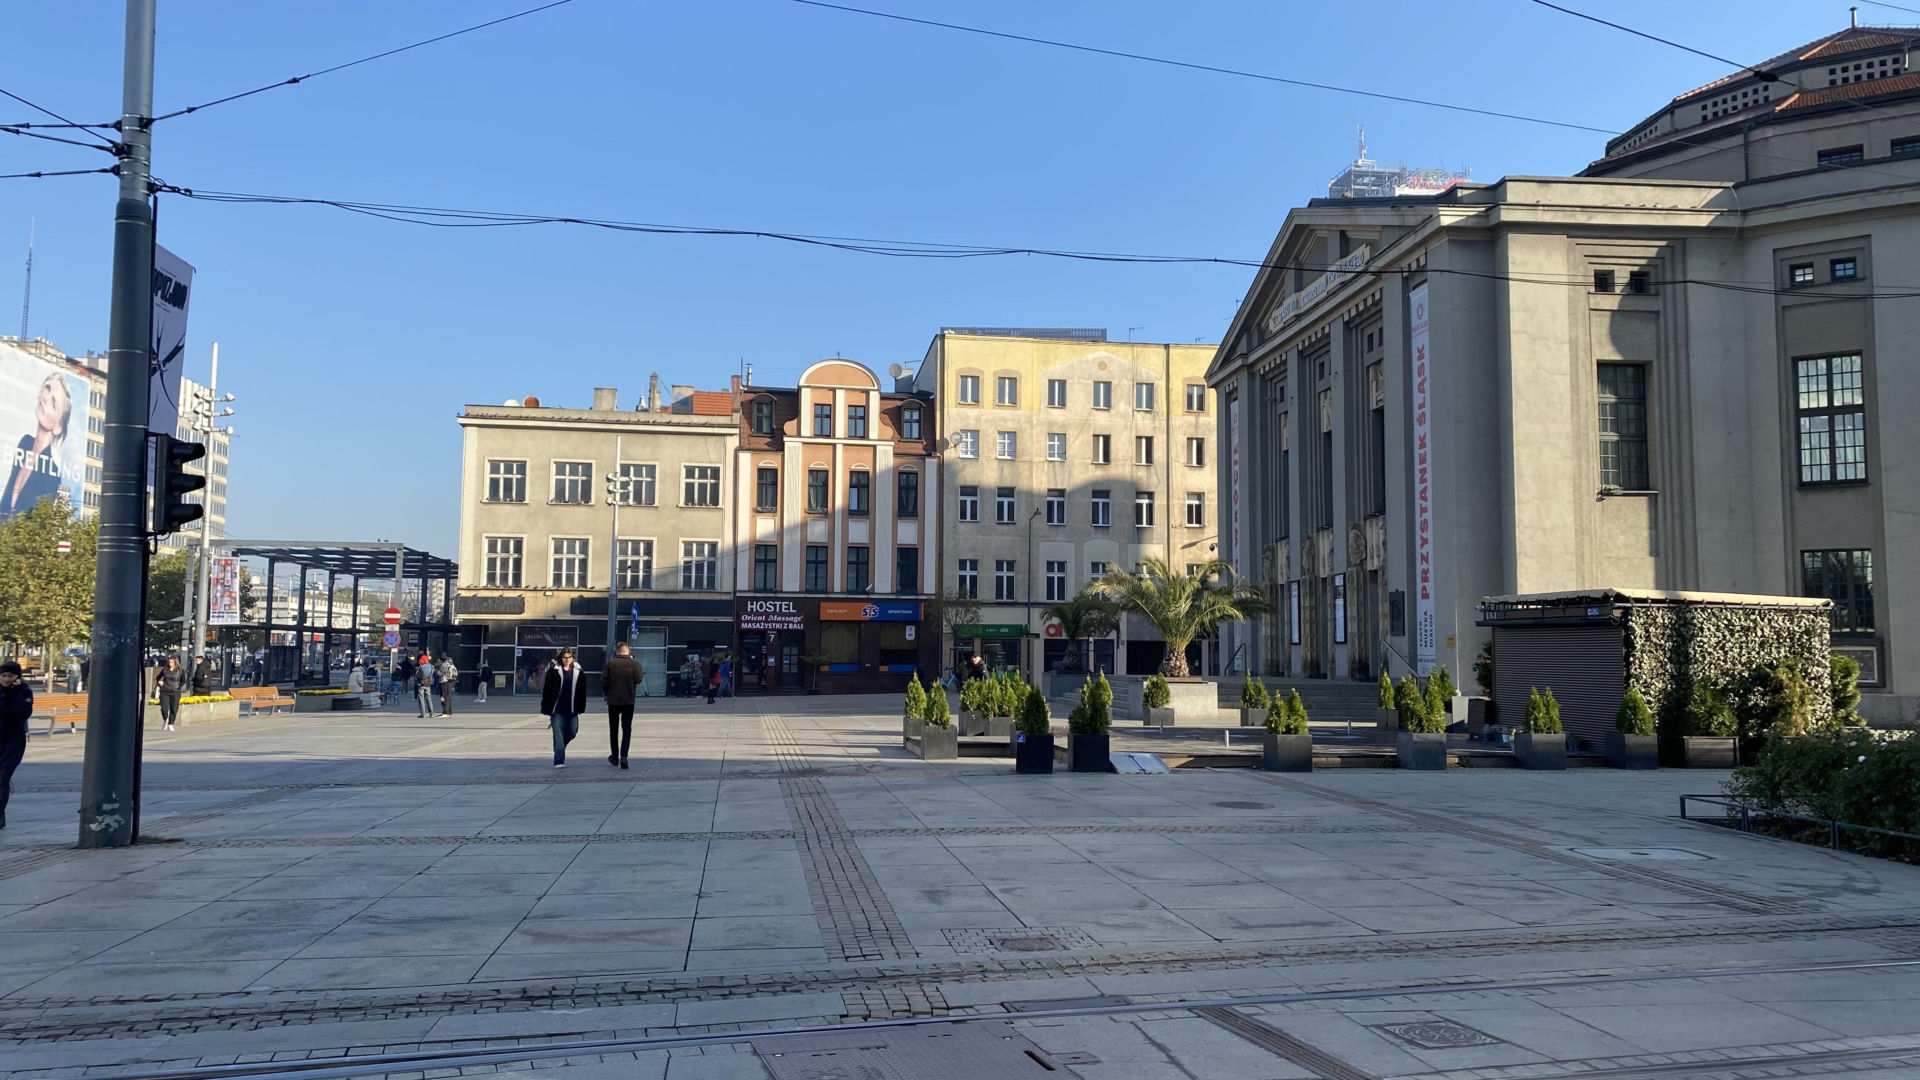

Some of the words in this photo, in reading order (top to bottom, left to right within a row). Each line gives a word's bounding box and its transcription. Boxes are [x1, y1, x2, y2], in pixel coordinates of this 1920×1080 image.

[1416, 344, 1428, 427] ŚLĄSK
[3, 446, 81, 482] BREITLING
[1418, 432, 1430, 600] PRZYSTANEK
[747, 600, 797, 612] HOSTEL
[861, 604, 880, 617] STS
[768, 615, 804, 623] Massage
[769, 634, 775, 642] 7
